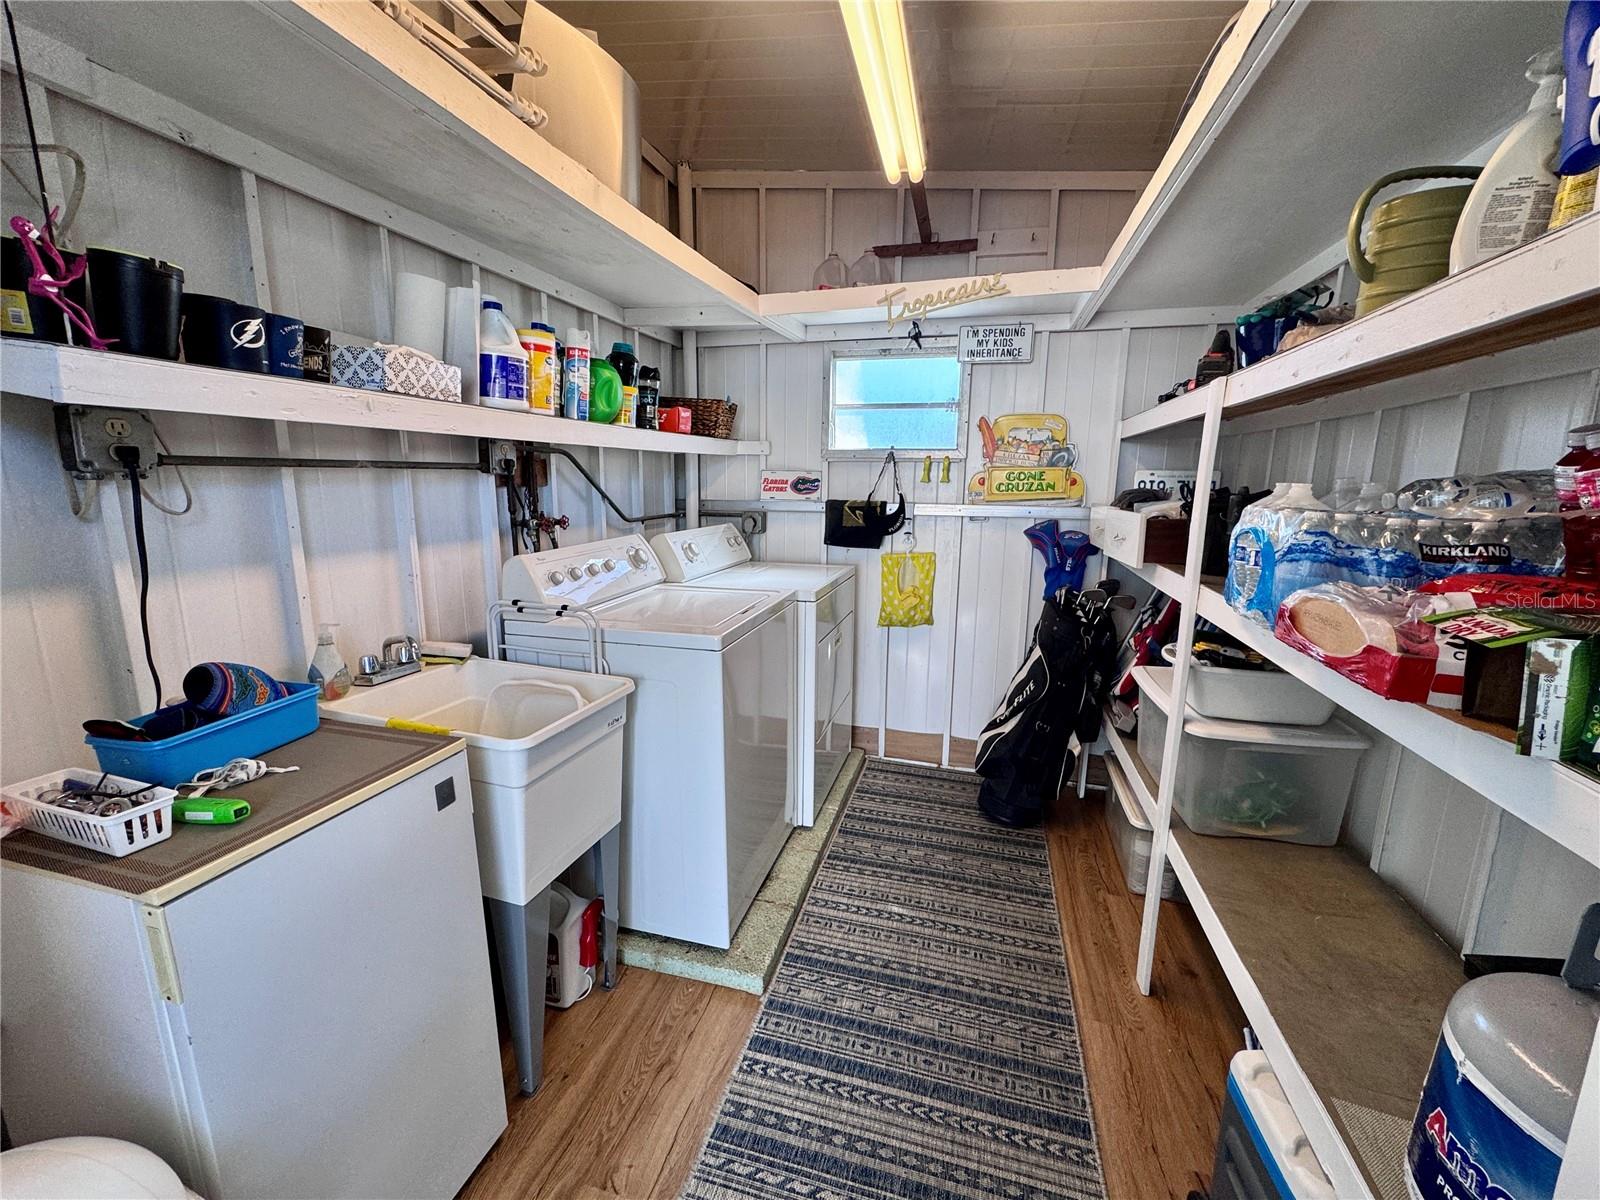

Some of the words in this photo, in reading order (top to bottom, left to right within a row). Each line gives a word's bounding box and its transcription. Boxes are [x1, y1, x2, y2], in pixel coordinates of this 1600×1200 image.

[966, 329, 980, 339] I'M
[982, 327, 1026, 339] SPENDING
[976, 339, 991, 348] MY
[993, 337, 1014, 348] KIDS
[966, 347, 1023, 359] INHERITANCE
[762, 477, 789, 485] FLORIDA
[1005, 471, 1046, 481] GONE
[995, 482, 1056, 492] CRUZAN
[1422, 545, 1509, 557] KIRKLAND
[1443, 623, 1480, 637] DRY
[1453, 616, 1519, 638] CANADA
